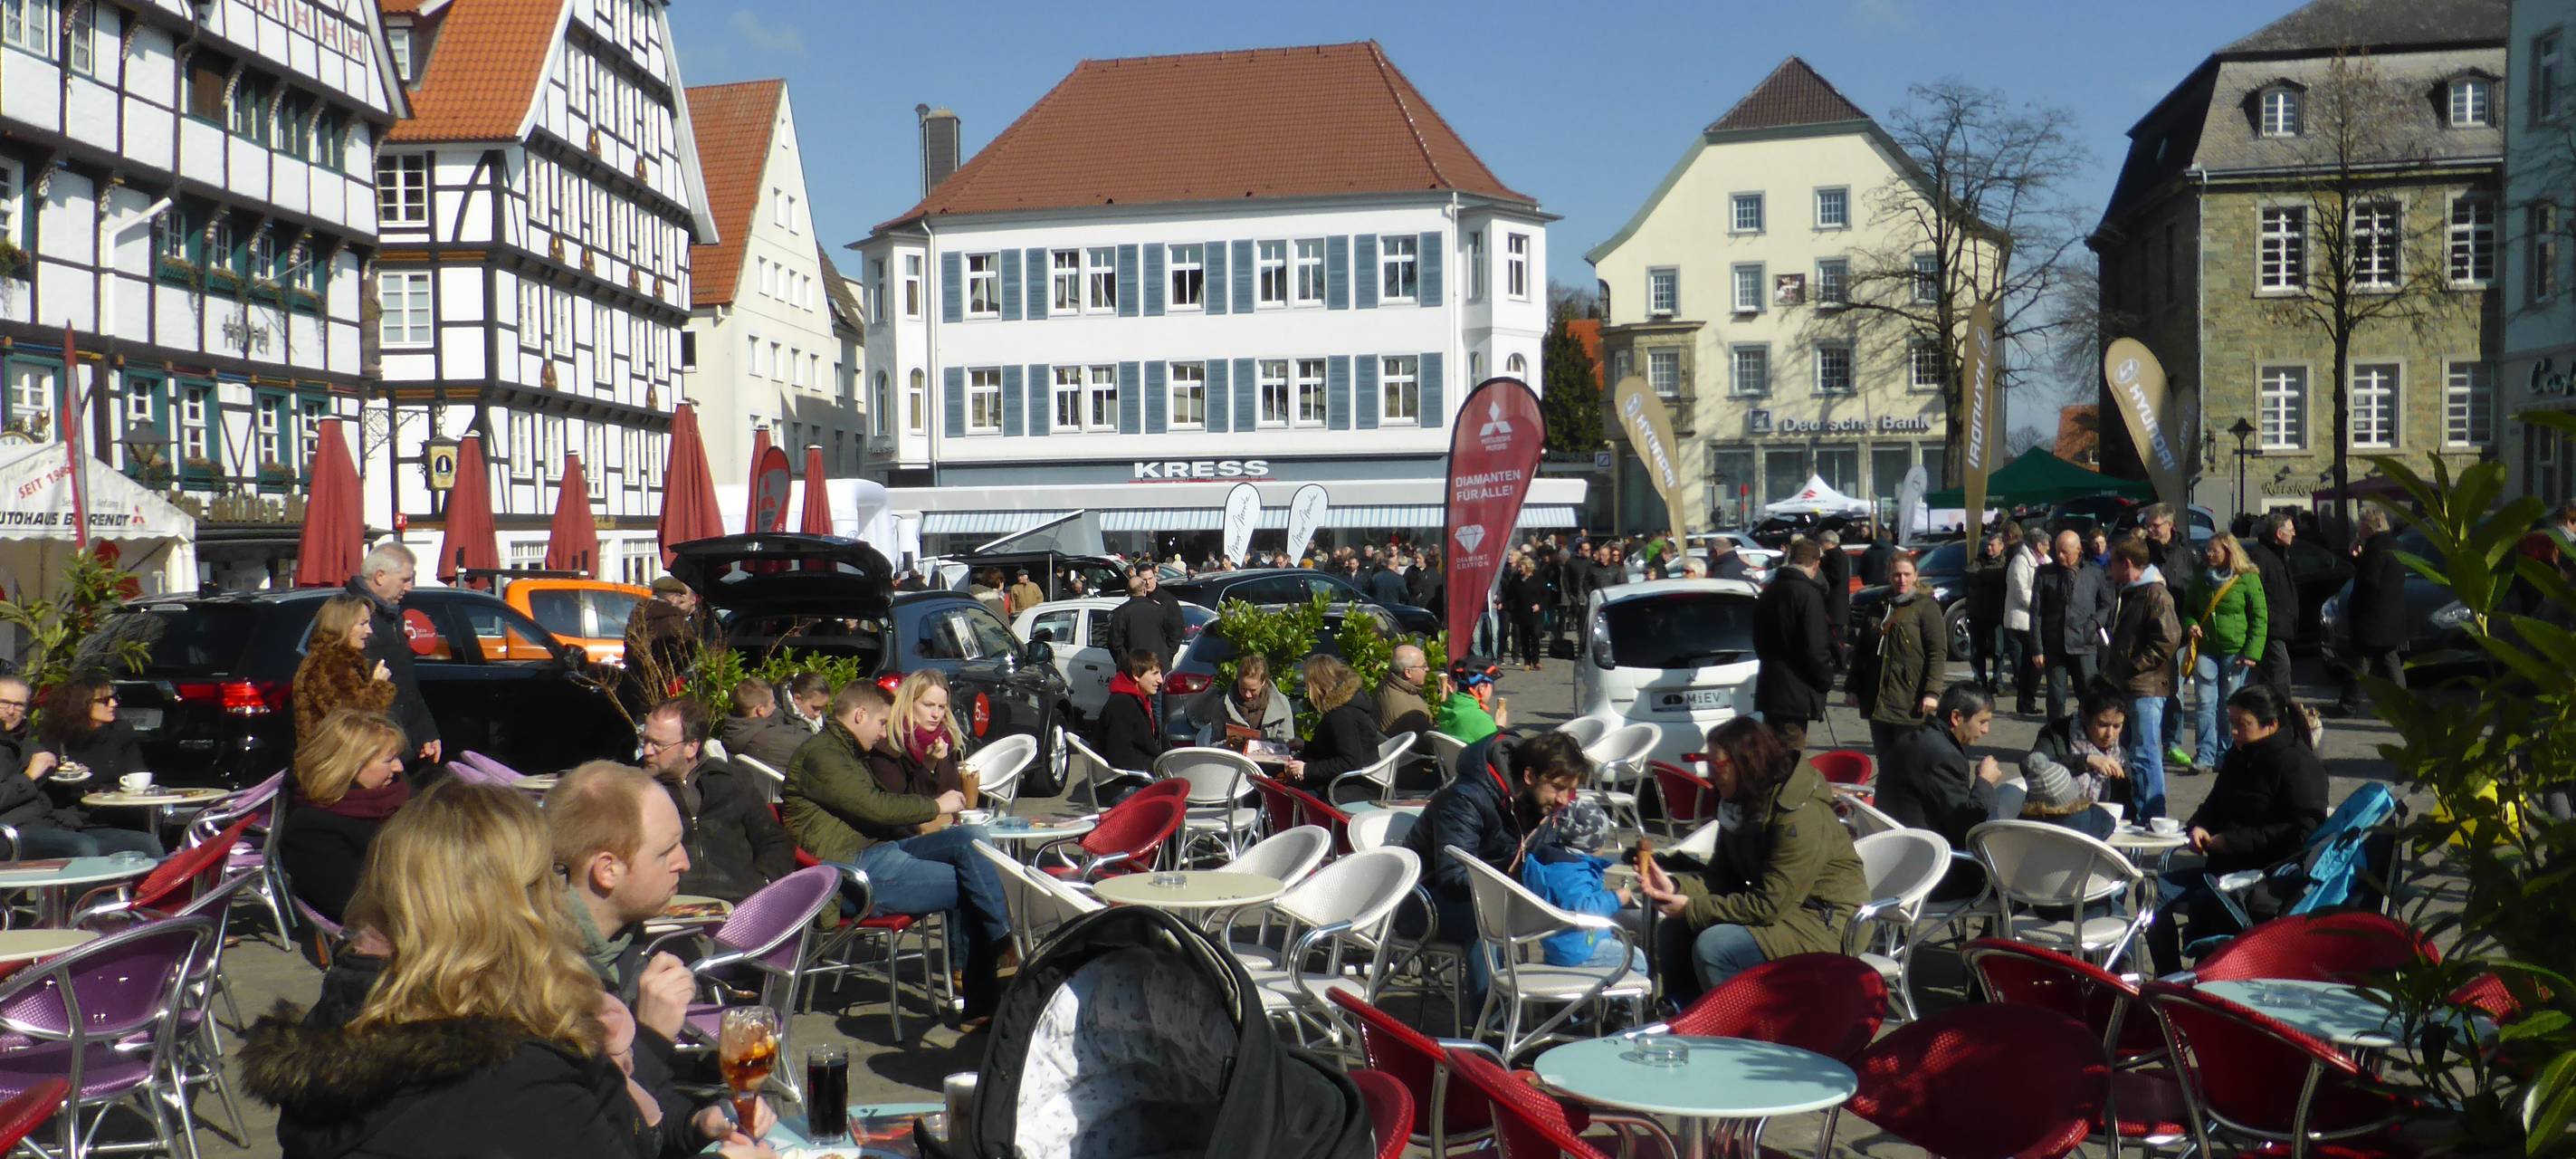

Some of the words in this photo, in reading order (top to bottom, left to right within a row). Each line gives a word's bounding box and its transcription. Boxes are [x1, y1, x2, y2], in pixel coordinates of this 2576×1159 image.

[1783, 417, 1877, 432] Deusche
[1882, 414, 1931, 429] Bank
[2130, 384, 2175, 470] HYUNDAI
[1636, 414, 1675, 488] HYUNDAI
[1134, 460, 1269, 478] KRESS
[1455, 469, 1522, 487] DIAMANTEN
[18, 477, 43, 499] SEIT
[1456, 488, 1479, 502] FÜR
[1481, 485, 1513, 499] ALLE!
[0, 511, 57, 526] UTOHAUS
[63, 512, 129, 527] BRENDT
[404, 619, 416, 639] 5
[1686, 693, 1722, 704] MiEV
[975, 702, 981, 722] 5
